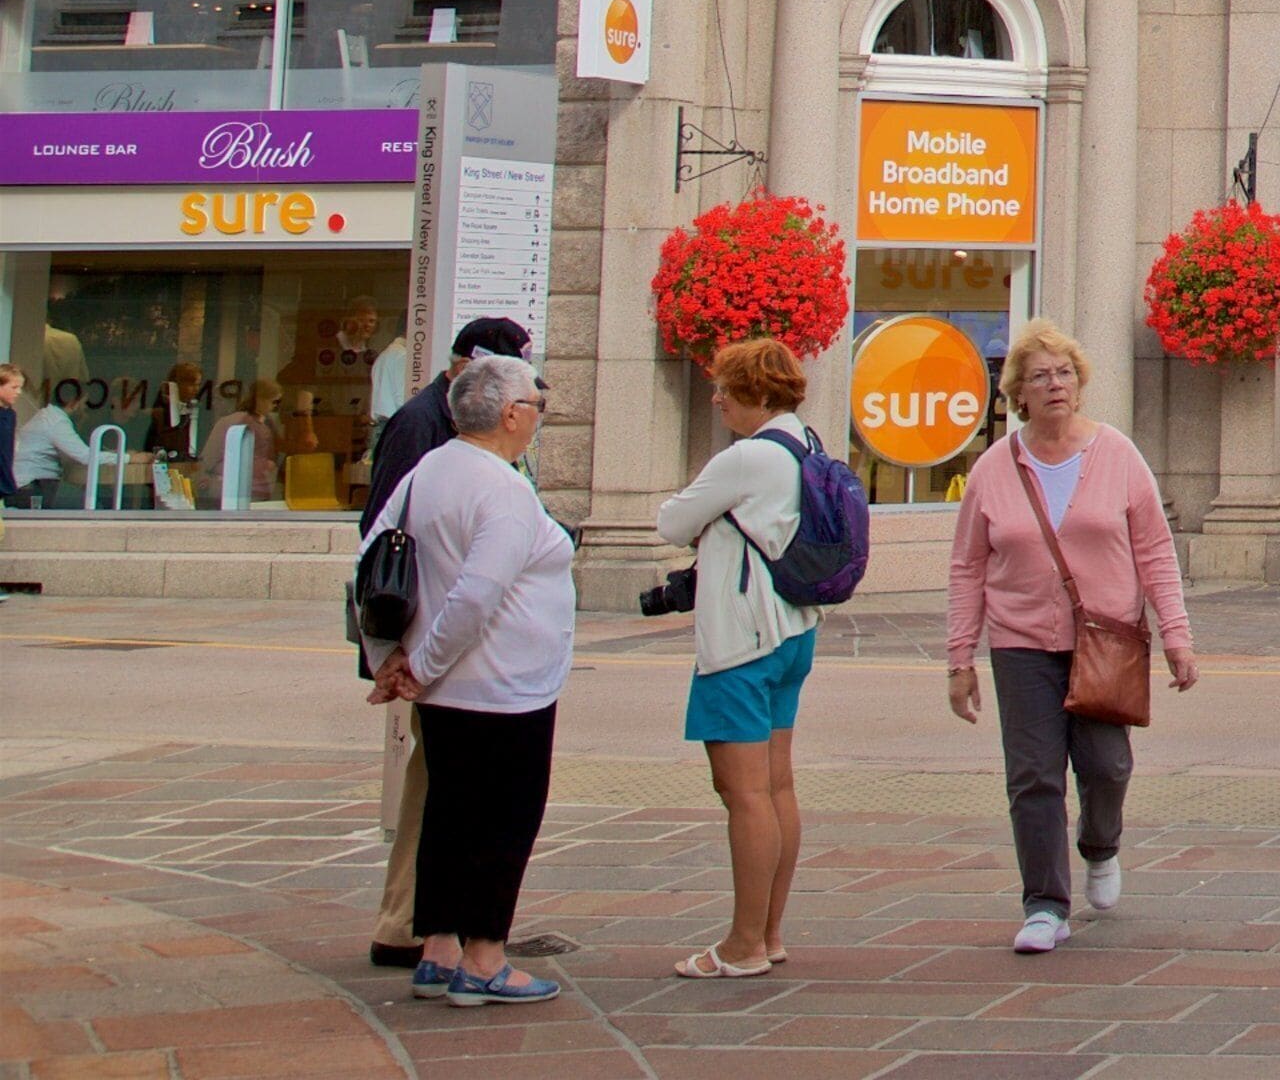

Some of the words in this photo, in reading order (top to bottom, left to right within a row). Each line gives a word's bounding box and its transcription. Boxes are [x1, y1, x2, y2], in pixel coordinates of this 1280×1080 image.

[33, 144, 100, 156] LOUNGE
[105, 143, 138, 156] BAR
[199, 121, 315, 170] Blush
[422, 126, 438, 159] King
[907, 128, 987, 155] Mobile
[421, 162, 436, 206] Street
[463, 166, 480, 180] King
[482, 167, 503, 179] Street
[508, 170, 523, 181] New
[525, 170, 545, 182] Street
[882, 159, 1009, 187] Broadband
[868, 191, 940, 216] Home
[947, 190, 1021, 218] Phone
[418, 219, 433, 251] New
[416, 255, 431, 300] Street
[411, 331, 427, 384] Couain
[862, 389, 980, 428] sure
